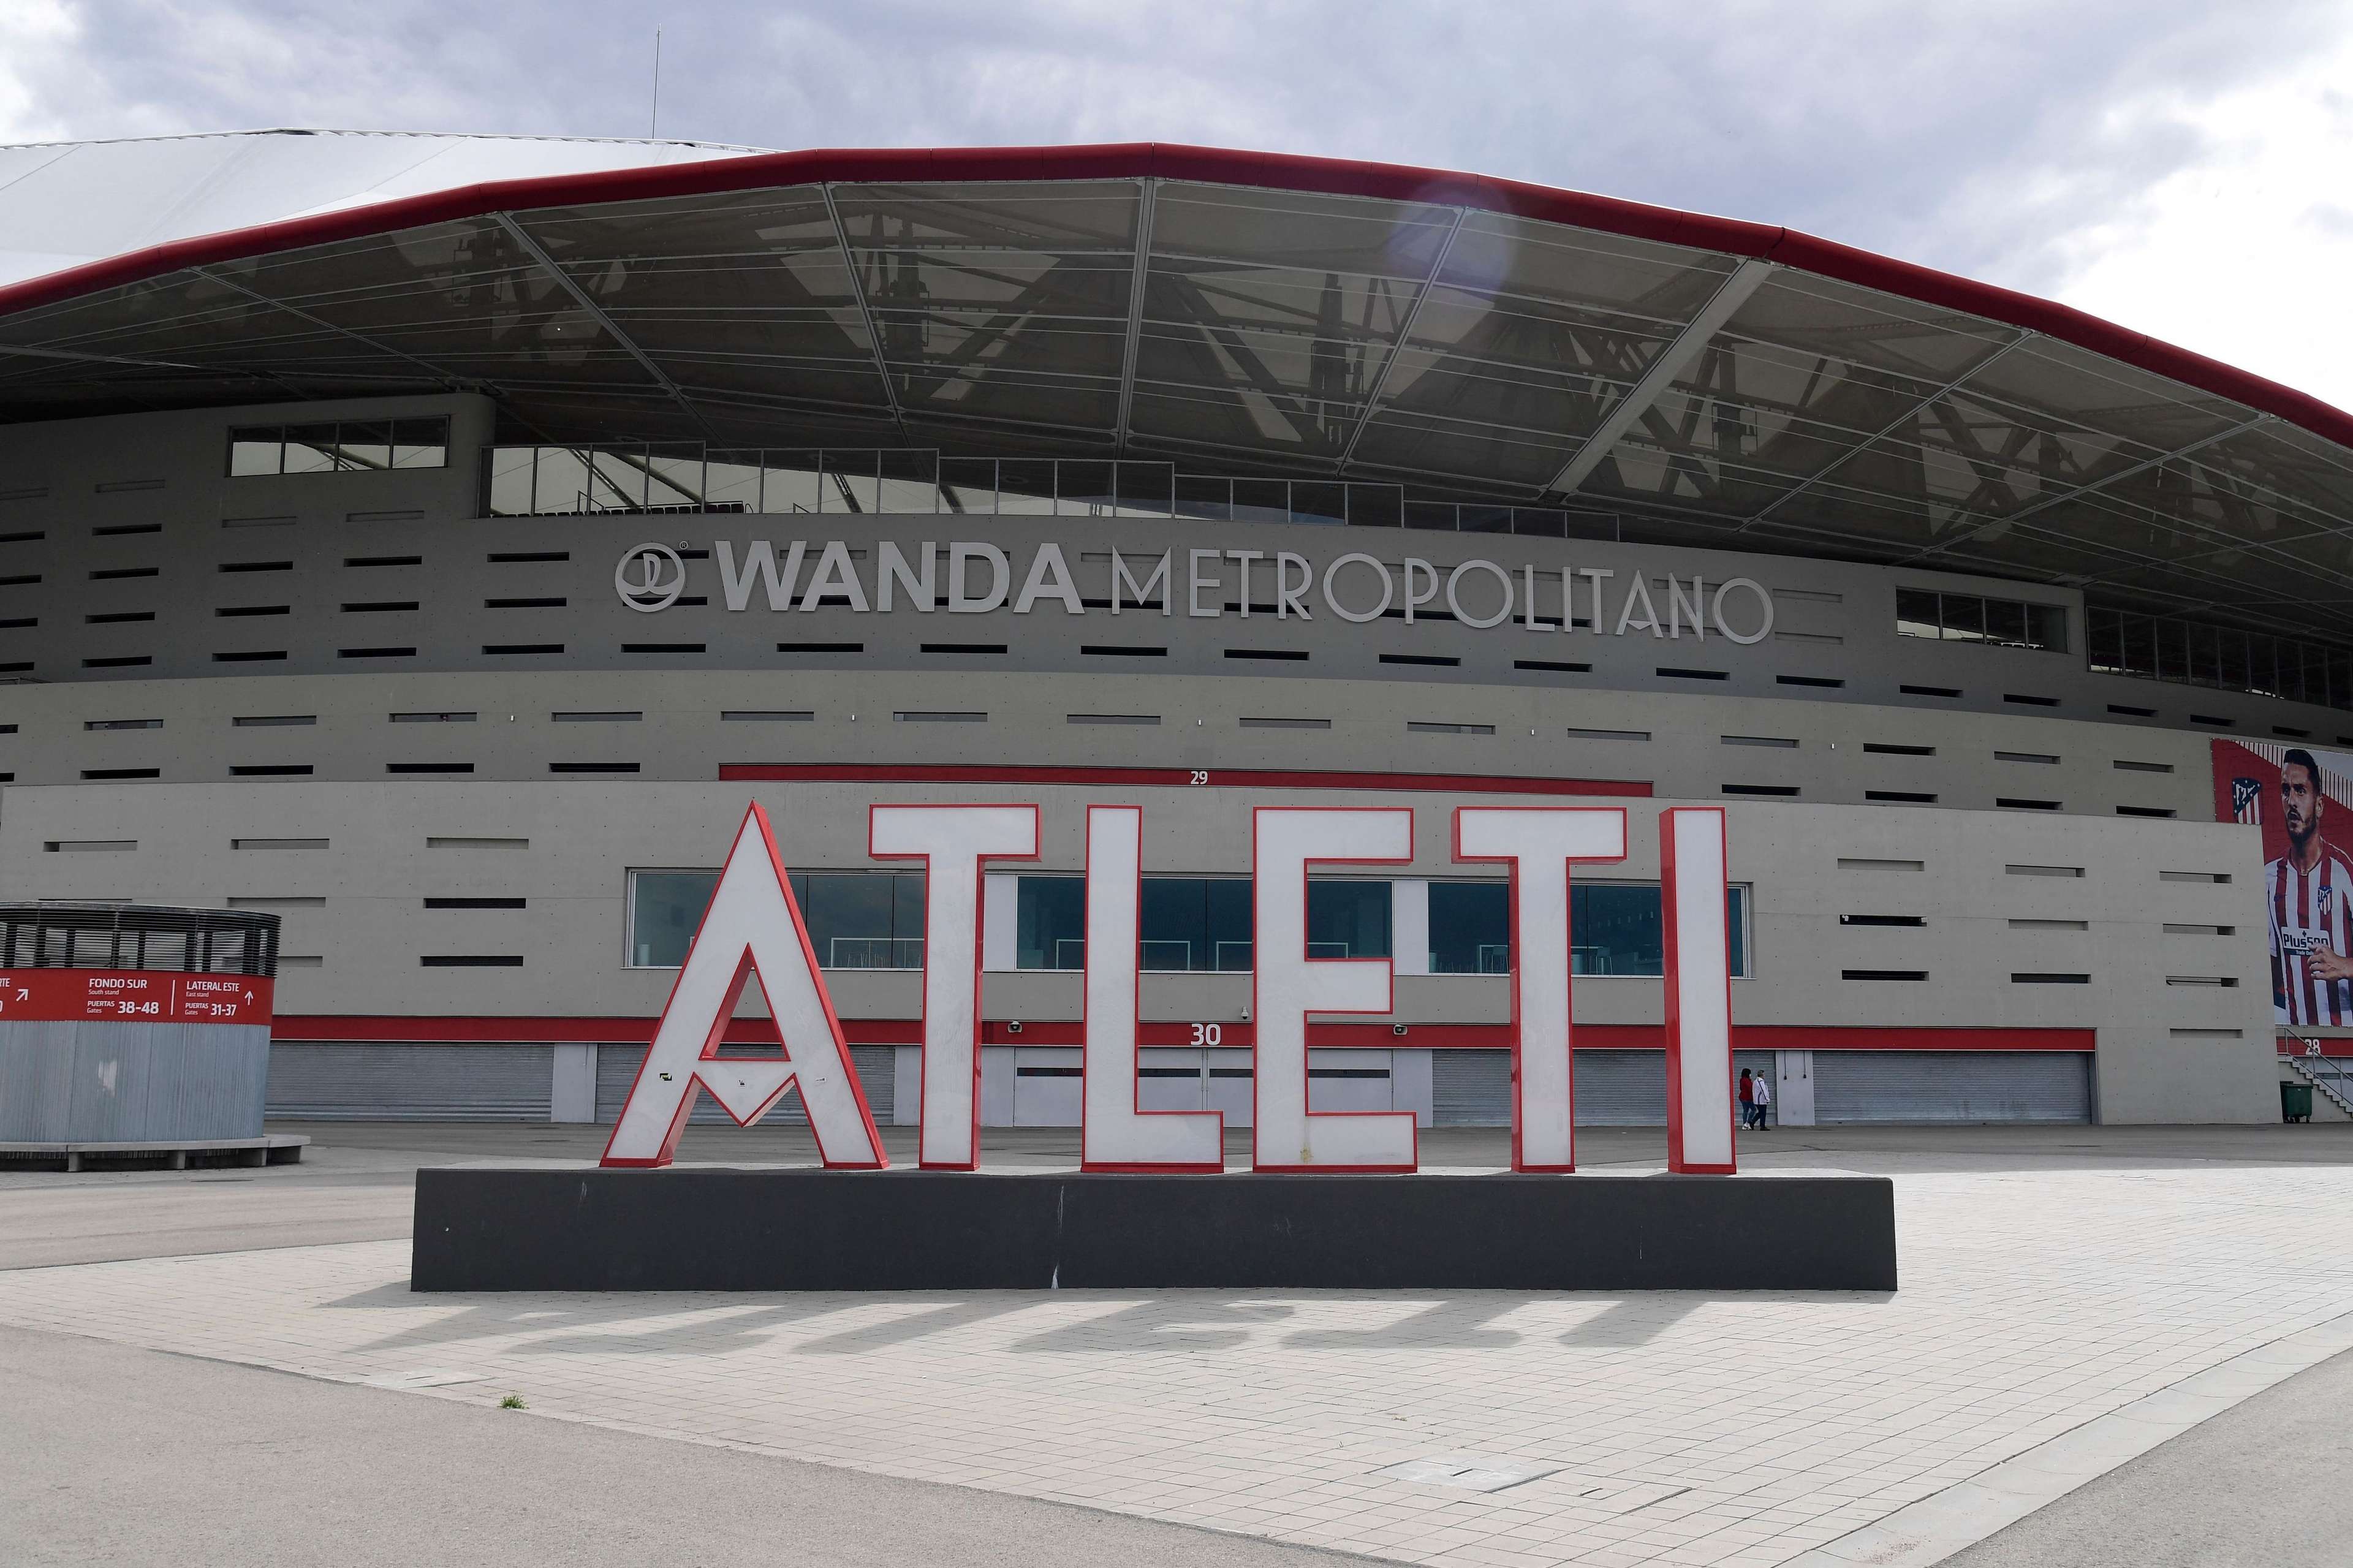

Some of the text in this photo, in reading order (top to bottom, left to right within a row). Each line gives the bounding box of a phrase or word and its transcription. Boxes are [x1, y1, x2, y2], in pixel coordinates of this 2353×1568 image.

[714, 539, 1774, 645] WANDA METROPOLITANO
[1191, 771, 1208, 784] 29
[89, 979, 148, 988] FONDO SUR
[186, 981, 240, 992] LATERAL ESTE
[599, 799, 1737, 1173] ATLETI
[118, 1001, 159, 1014] 38-48
[211, 1003, 237, 1017] 31-37
[1191, 1023, 1221, 1045] 30
[2305, 1039, 2321, 1056] 28
